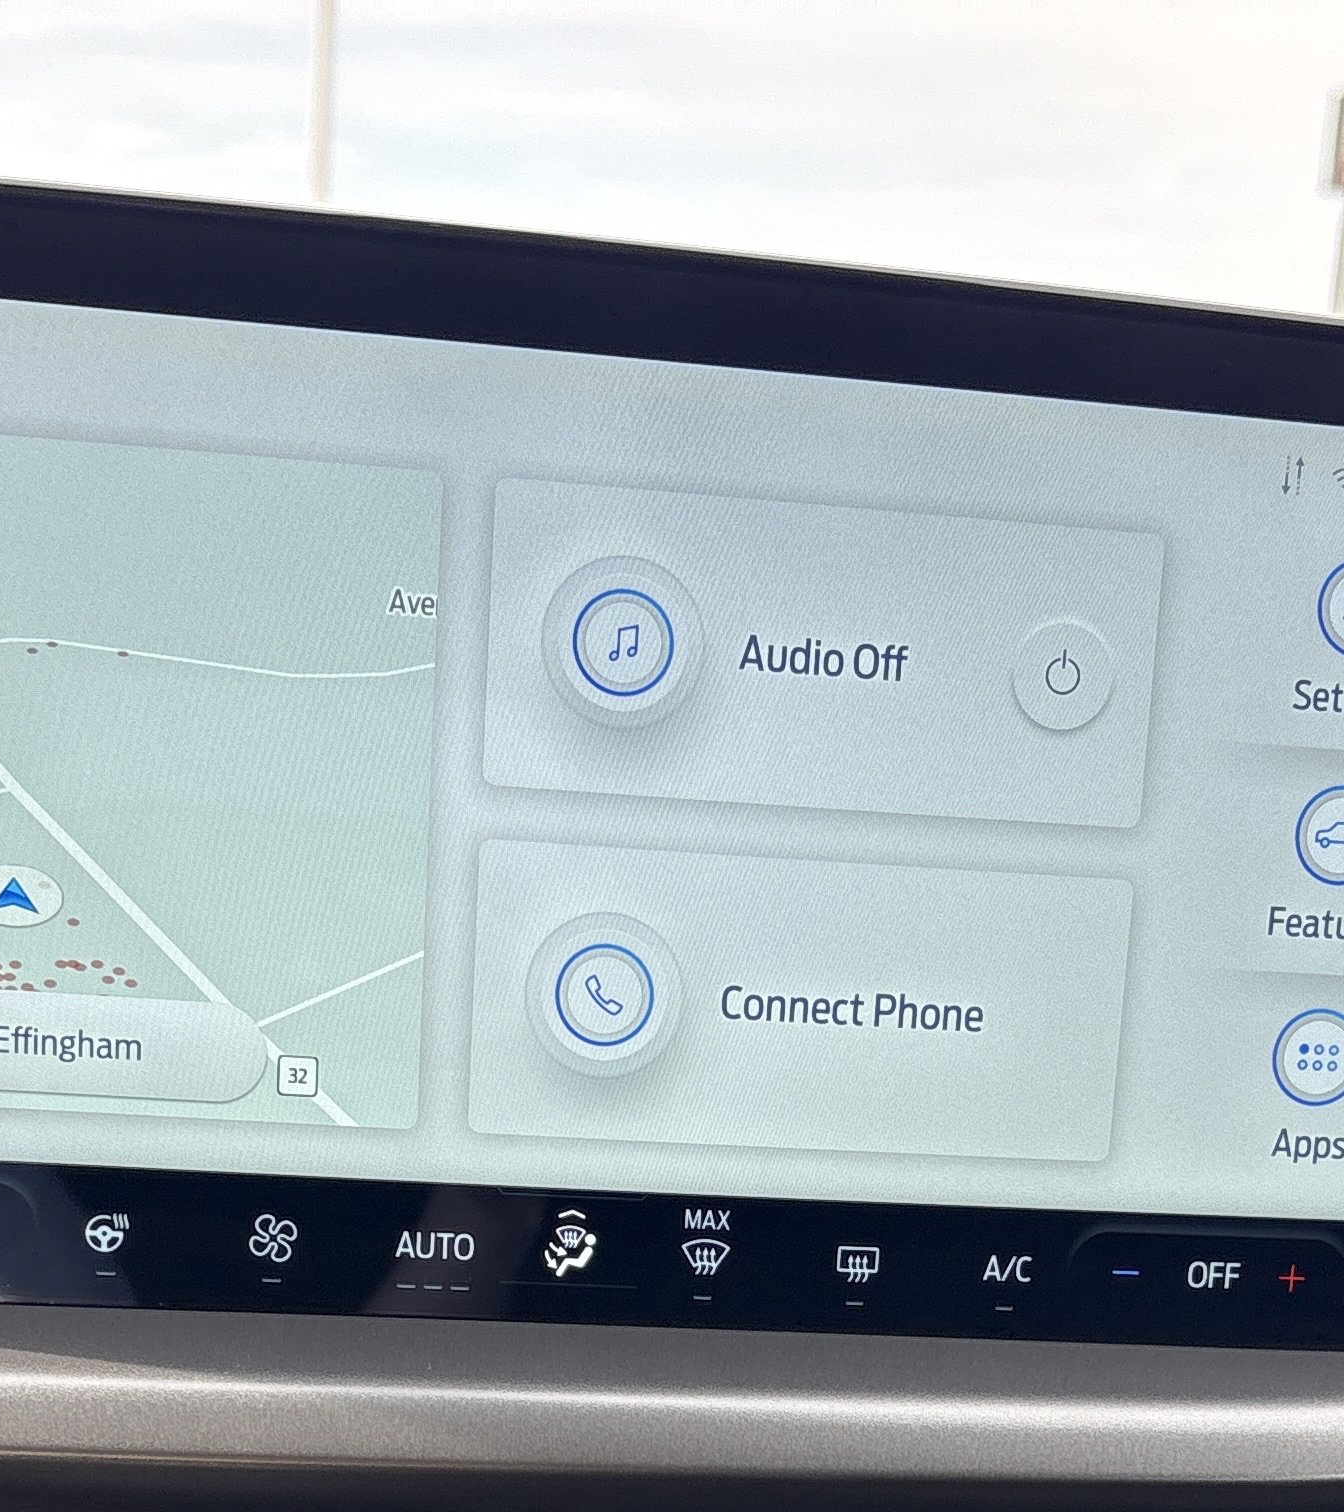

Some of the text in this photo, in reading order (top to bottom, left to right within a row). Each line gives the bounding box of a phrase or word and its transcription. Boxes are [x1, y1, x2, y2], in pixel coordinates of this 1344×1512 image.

[389, 588, 438, 616] Ave
[739, 634, 909, 682] Audio Off
[721, 985, 984, 1030] Connect Phone
[288, 1067, 308, 1085] 32
[684, 1208, 731, 1231] MAX
[395, 1230, 475, 1261] AUTO
[982, 1254, 1032, 1283] A/C
[1187, 1260, 1241, 1289] OFF
